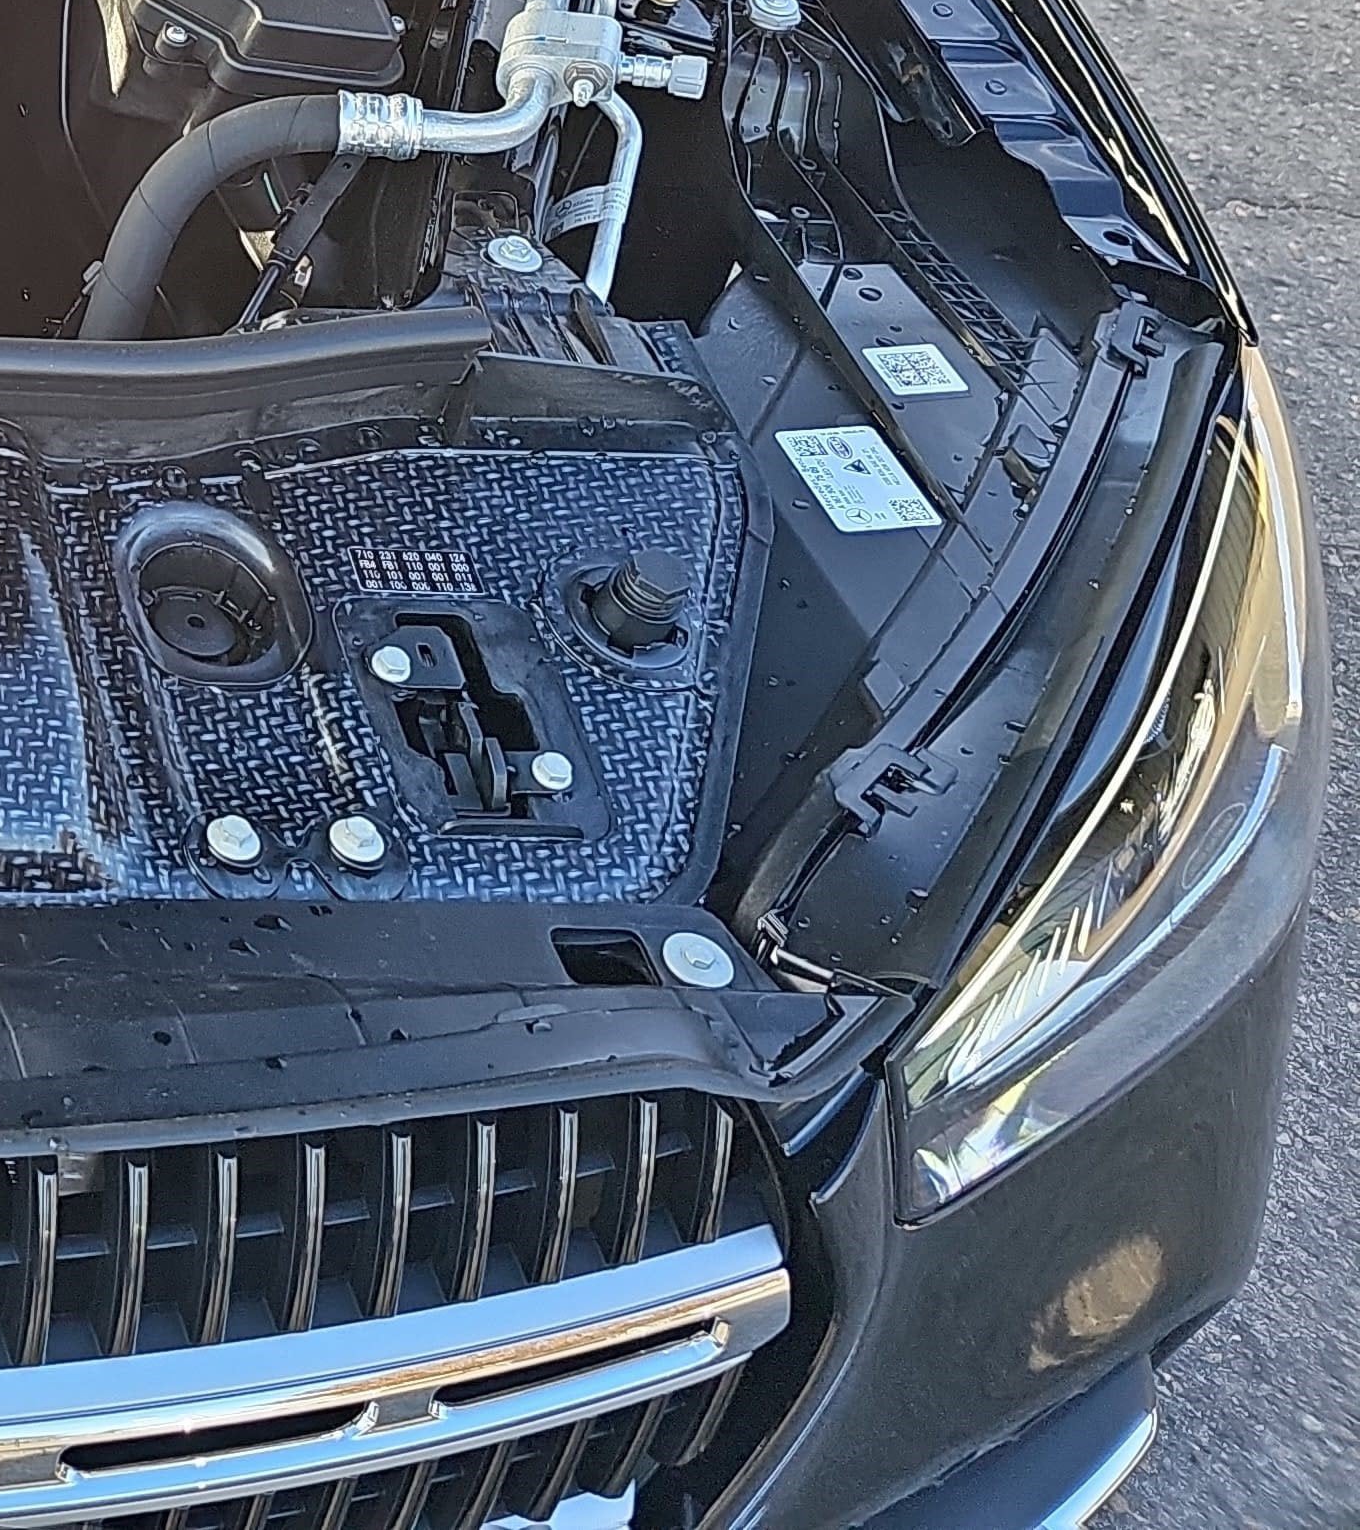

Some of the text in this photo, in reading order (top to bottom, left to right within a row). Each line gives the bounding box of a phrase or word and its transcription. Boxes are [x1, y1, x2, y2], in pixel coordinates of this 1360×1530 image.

[355, 549, 465, 562] 710 231 620 040 124
[406, 562, 423, 571] 110
[427, 562, 445, 571] 001
[451, 563, 469, 572] 000
[362, 570, 472, 582] 110 101 001 001 011
[366, 580, 383, 588] 001
[435, 582, 453, 590] 110
